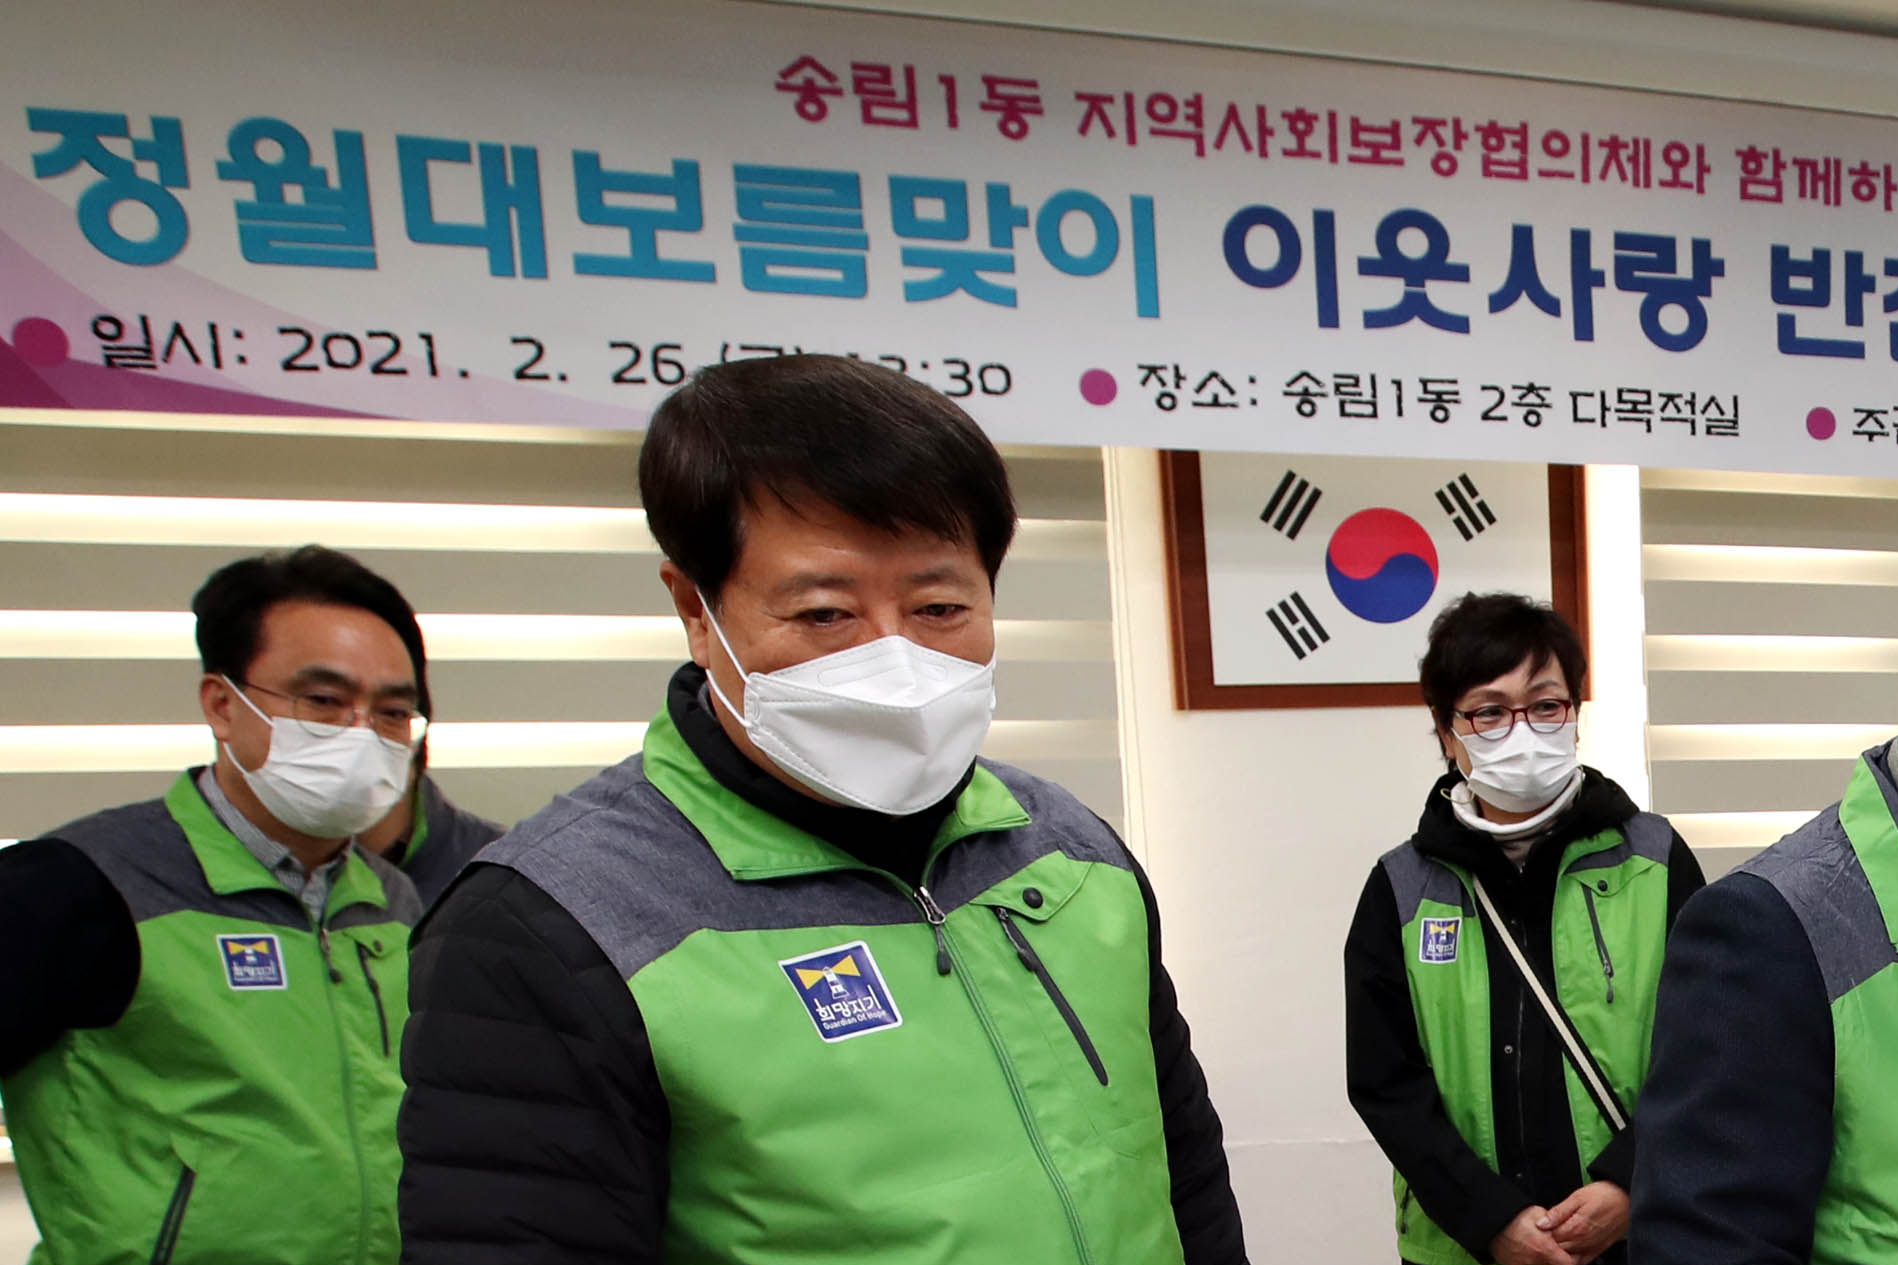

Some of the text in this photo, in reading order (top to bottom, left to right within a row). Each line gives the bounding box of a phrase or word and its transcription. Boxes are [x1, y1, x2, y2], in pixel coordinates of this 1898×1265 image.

[774, 54, 1045, 142] 송림1동
[1075, 90, 1712, 196] 지역사회보장협의체와
[25, 105, 1161, 321] 정월대보름맞이
[1222, 203, 1726, 353] 이웃사랑
[90, 313, 247, 371] 일시:
[276, 325, 470, 382] 2021.
[511, 337, 569, 384] 2.
[1137, 361, 1742, 438] 장소: 송림1동 2층 다목적실
[813, 984, 882, 1022] 희망지기
